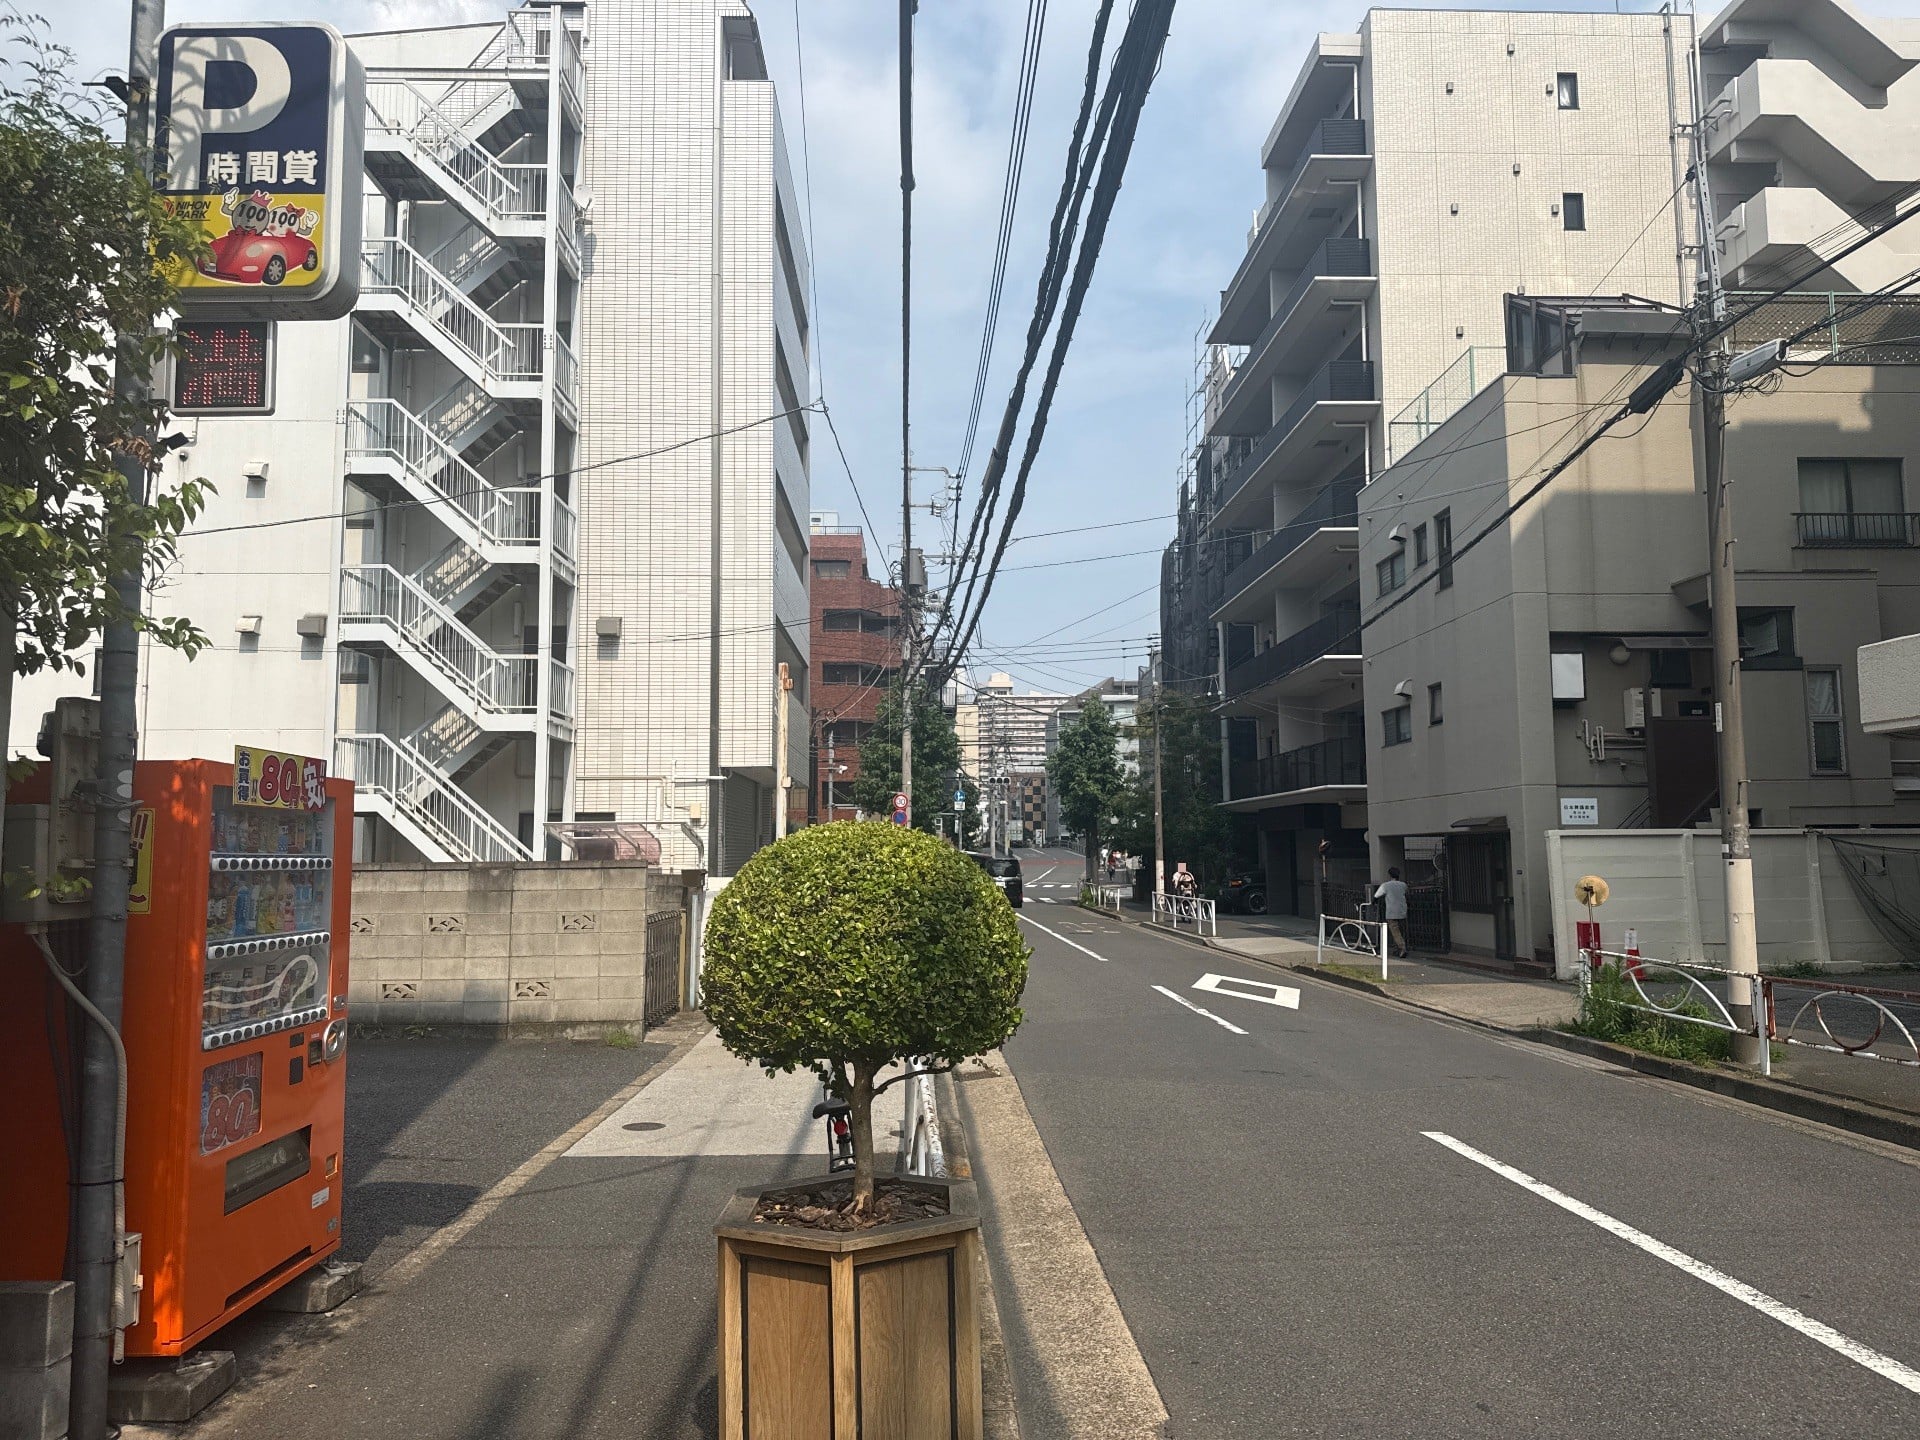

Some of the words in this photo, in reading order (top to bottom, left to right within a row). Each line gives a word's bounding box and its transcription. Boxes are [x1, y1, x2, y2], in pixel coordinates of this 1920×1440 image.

[166, 36, 292, 191] P
[206, 150, 318, 185] 時間貸
[176, 200, 211, 210] NIHON
[239, 203, 267, 221] 100
[176, 210, 207, 219] PARK
[270, 211, 297, 226] 100
[182, 327, 263, 405] 満
[896, 797, 906, 806] 30
